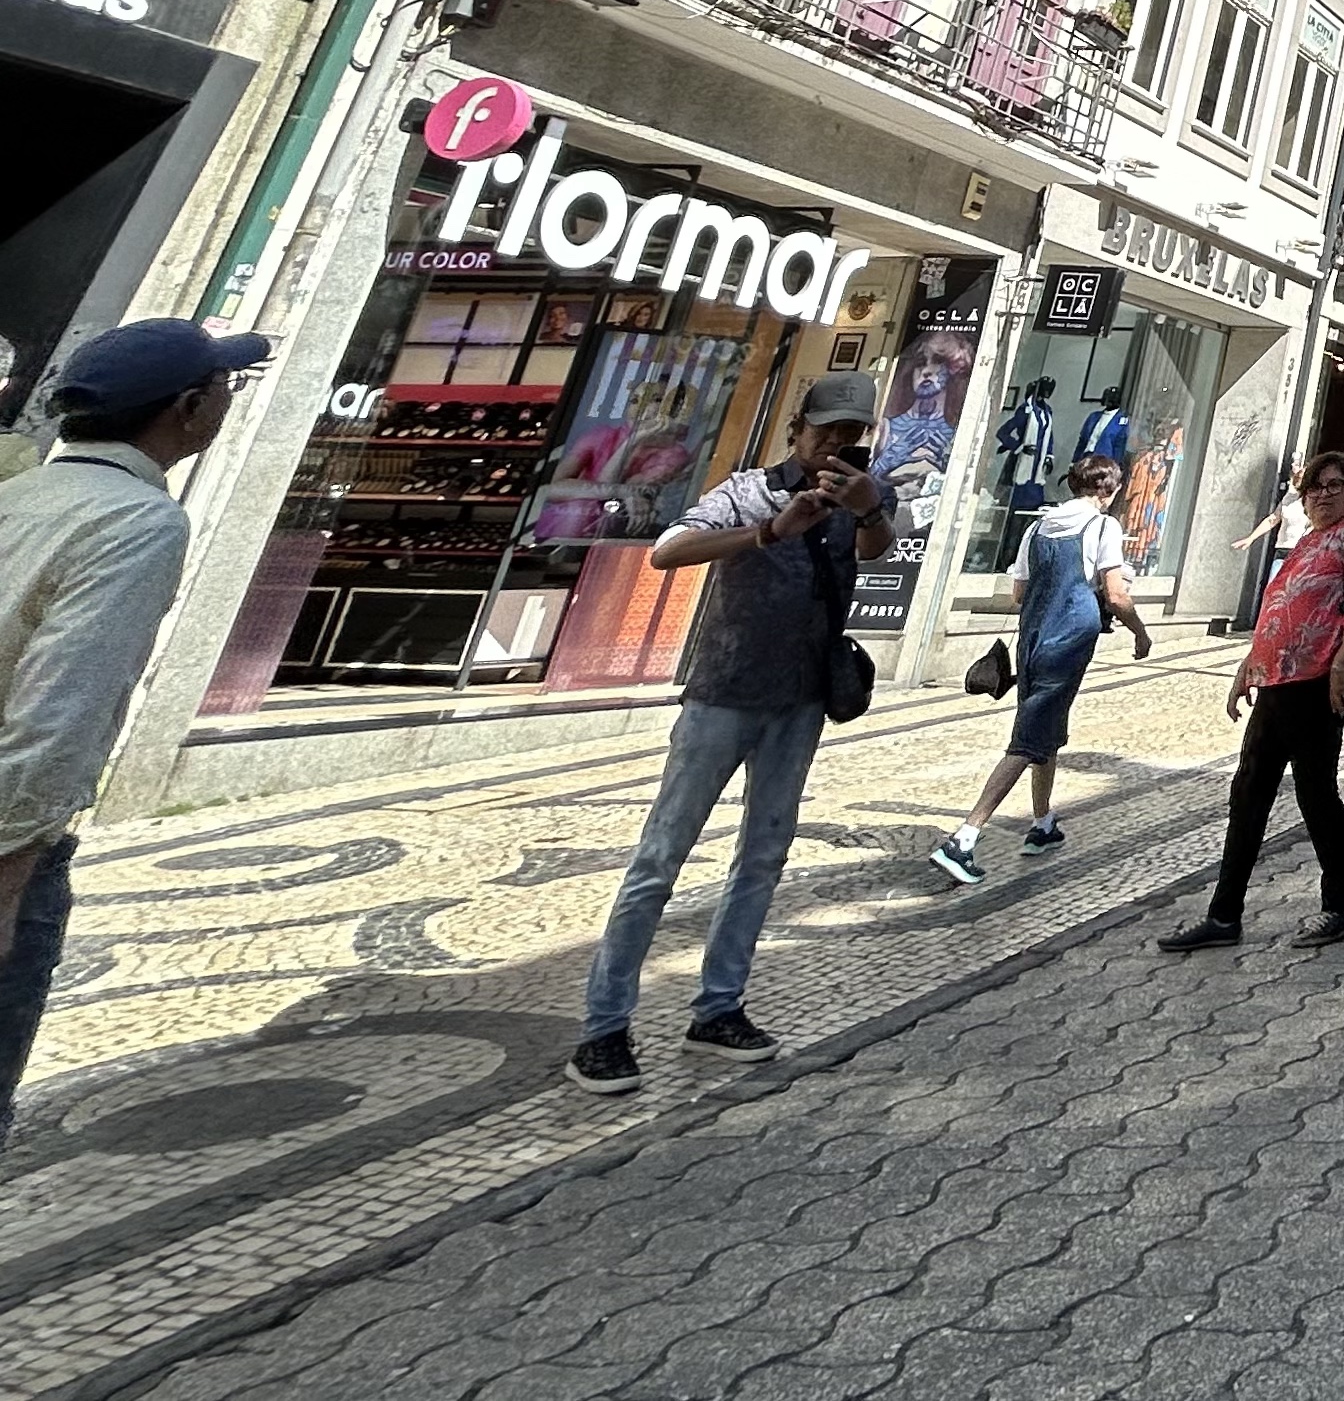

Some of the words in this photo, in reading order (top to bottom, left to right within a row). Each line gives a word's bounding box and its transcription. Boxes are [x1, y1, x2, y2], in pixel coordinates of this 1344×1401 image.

[418, 252, 492, 270] COLOR
[1101, 205, 1270, 309] BRUXELAS
[860, 605, 904, 617] PORTO
